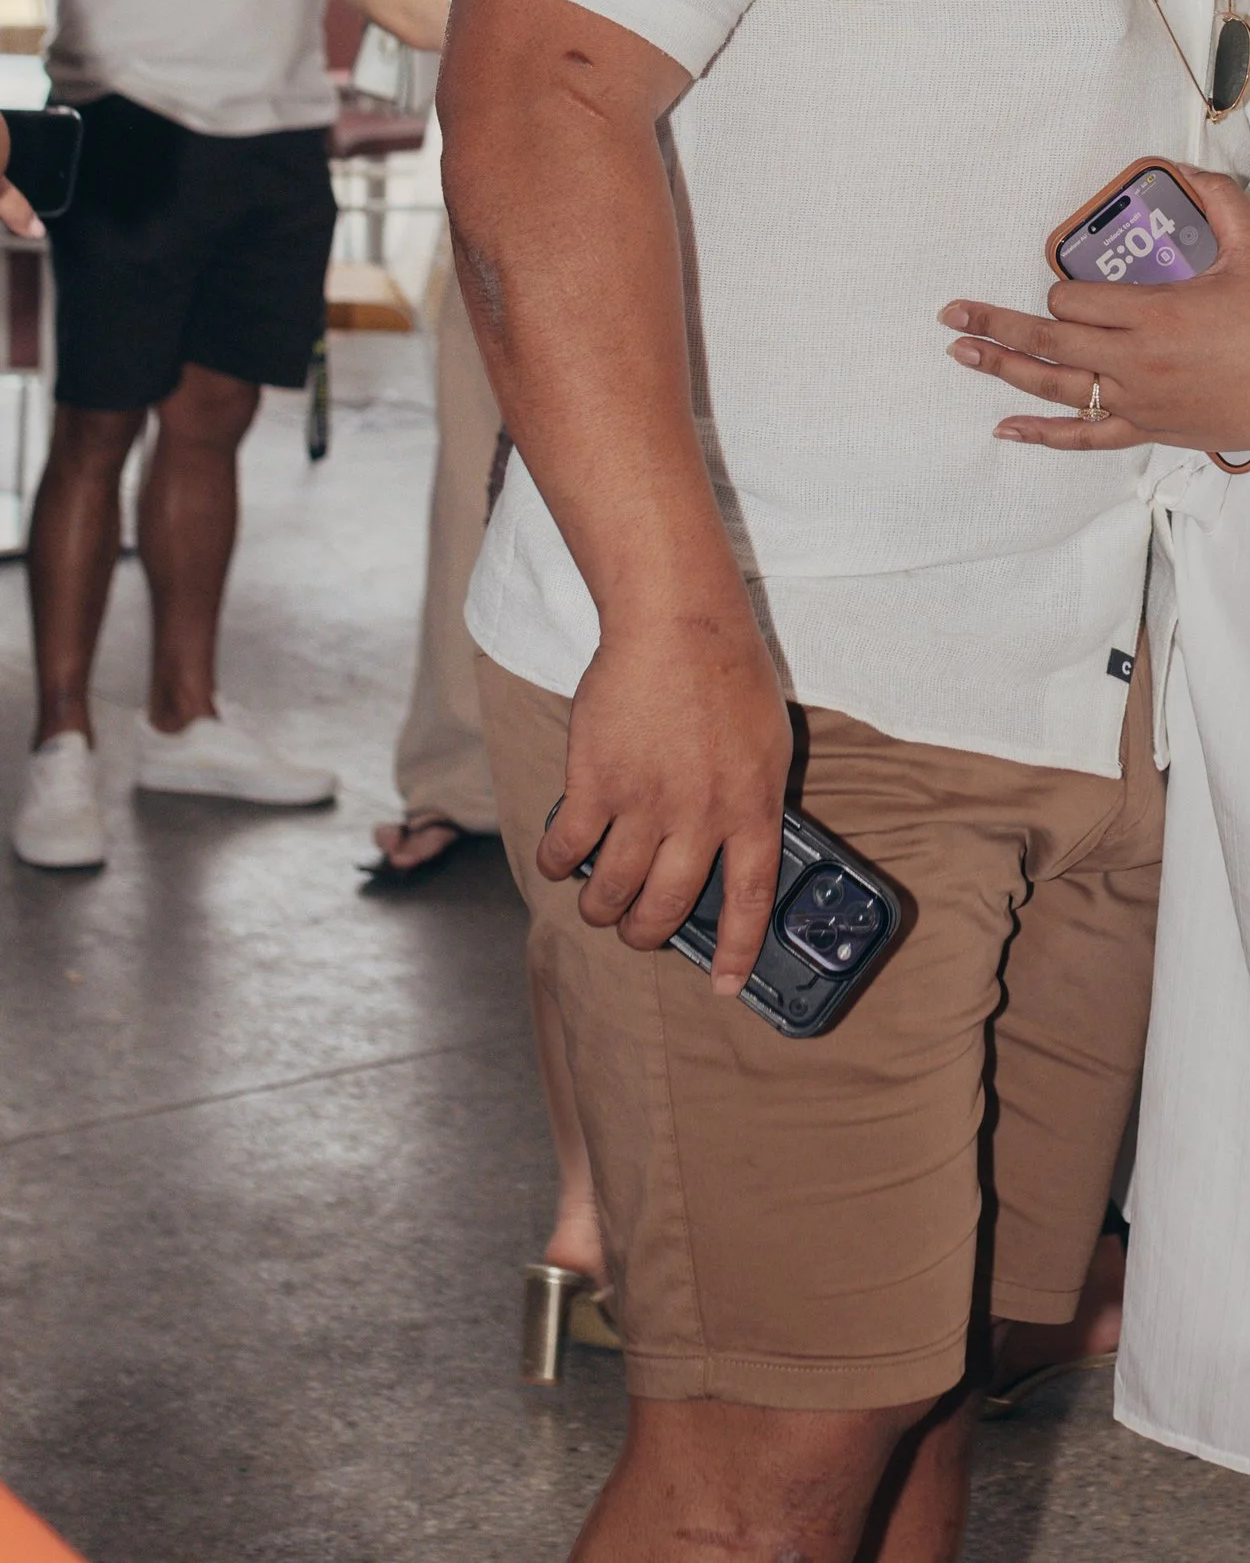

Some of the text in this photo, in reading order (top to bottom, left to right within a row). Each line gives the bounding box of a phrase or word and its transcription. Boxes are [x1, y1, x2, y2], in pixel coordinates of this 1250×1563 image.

[1095, 207, 1176, 282] 5:04
[1103, 212, 1142, 246] Unlock to edit
